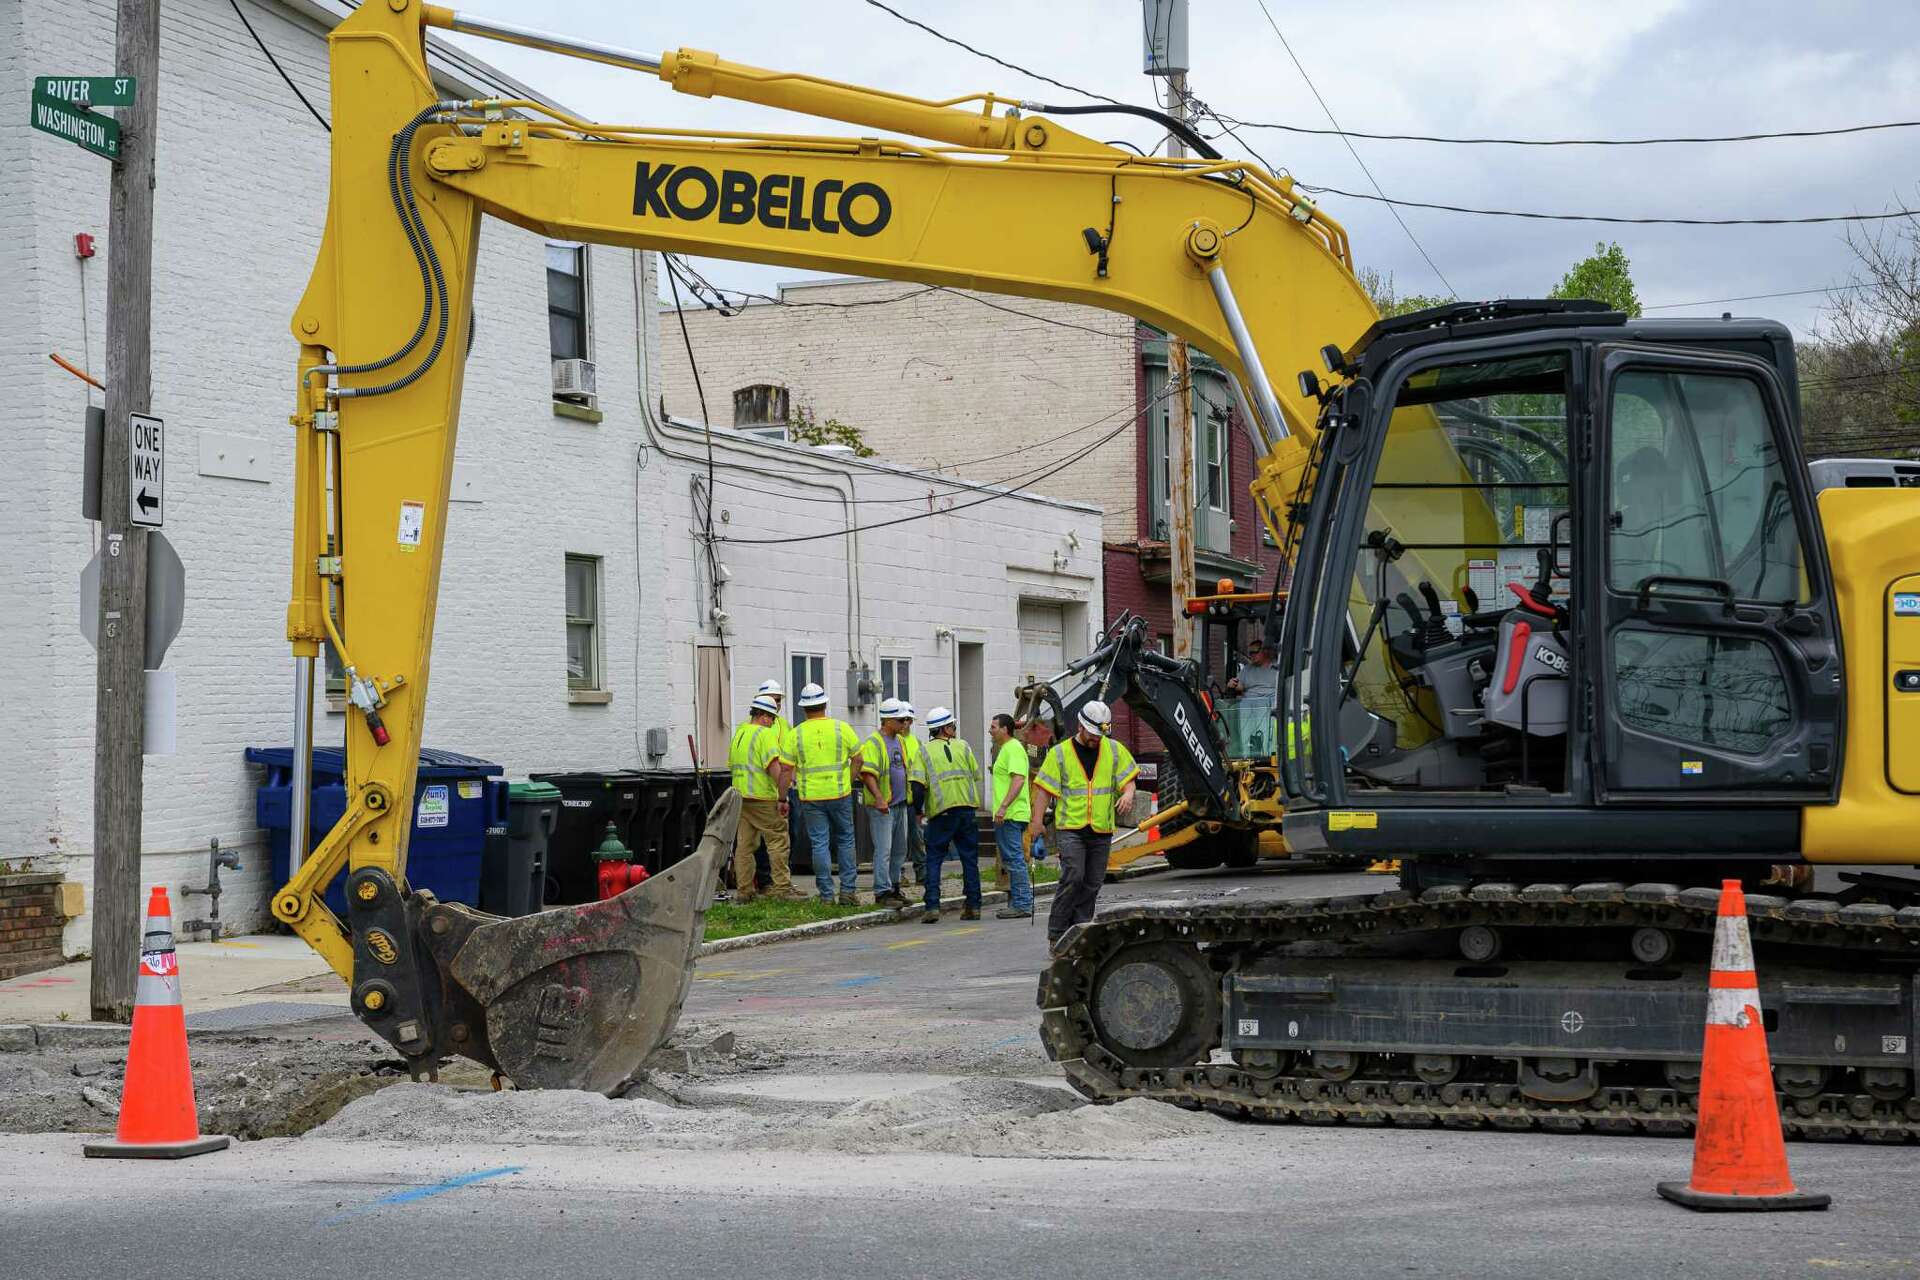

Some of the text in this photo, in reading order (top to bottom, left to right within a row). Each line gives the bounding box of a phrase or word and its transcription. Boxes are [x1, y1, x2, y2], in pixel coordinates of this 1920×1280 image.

[47, 79, 129, 101] RIVER ST
[37, 103, 116, 152] WASHINGTON ST
[632, 160, 892, 238] KOBELCO
[135, 423, 160, 452] ONE
[134, 454, 161, 483] WAY
[109, 541, 120, 557] 6
[1173, 701, 1214, 777] DEERE
